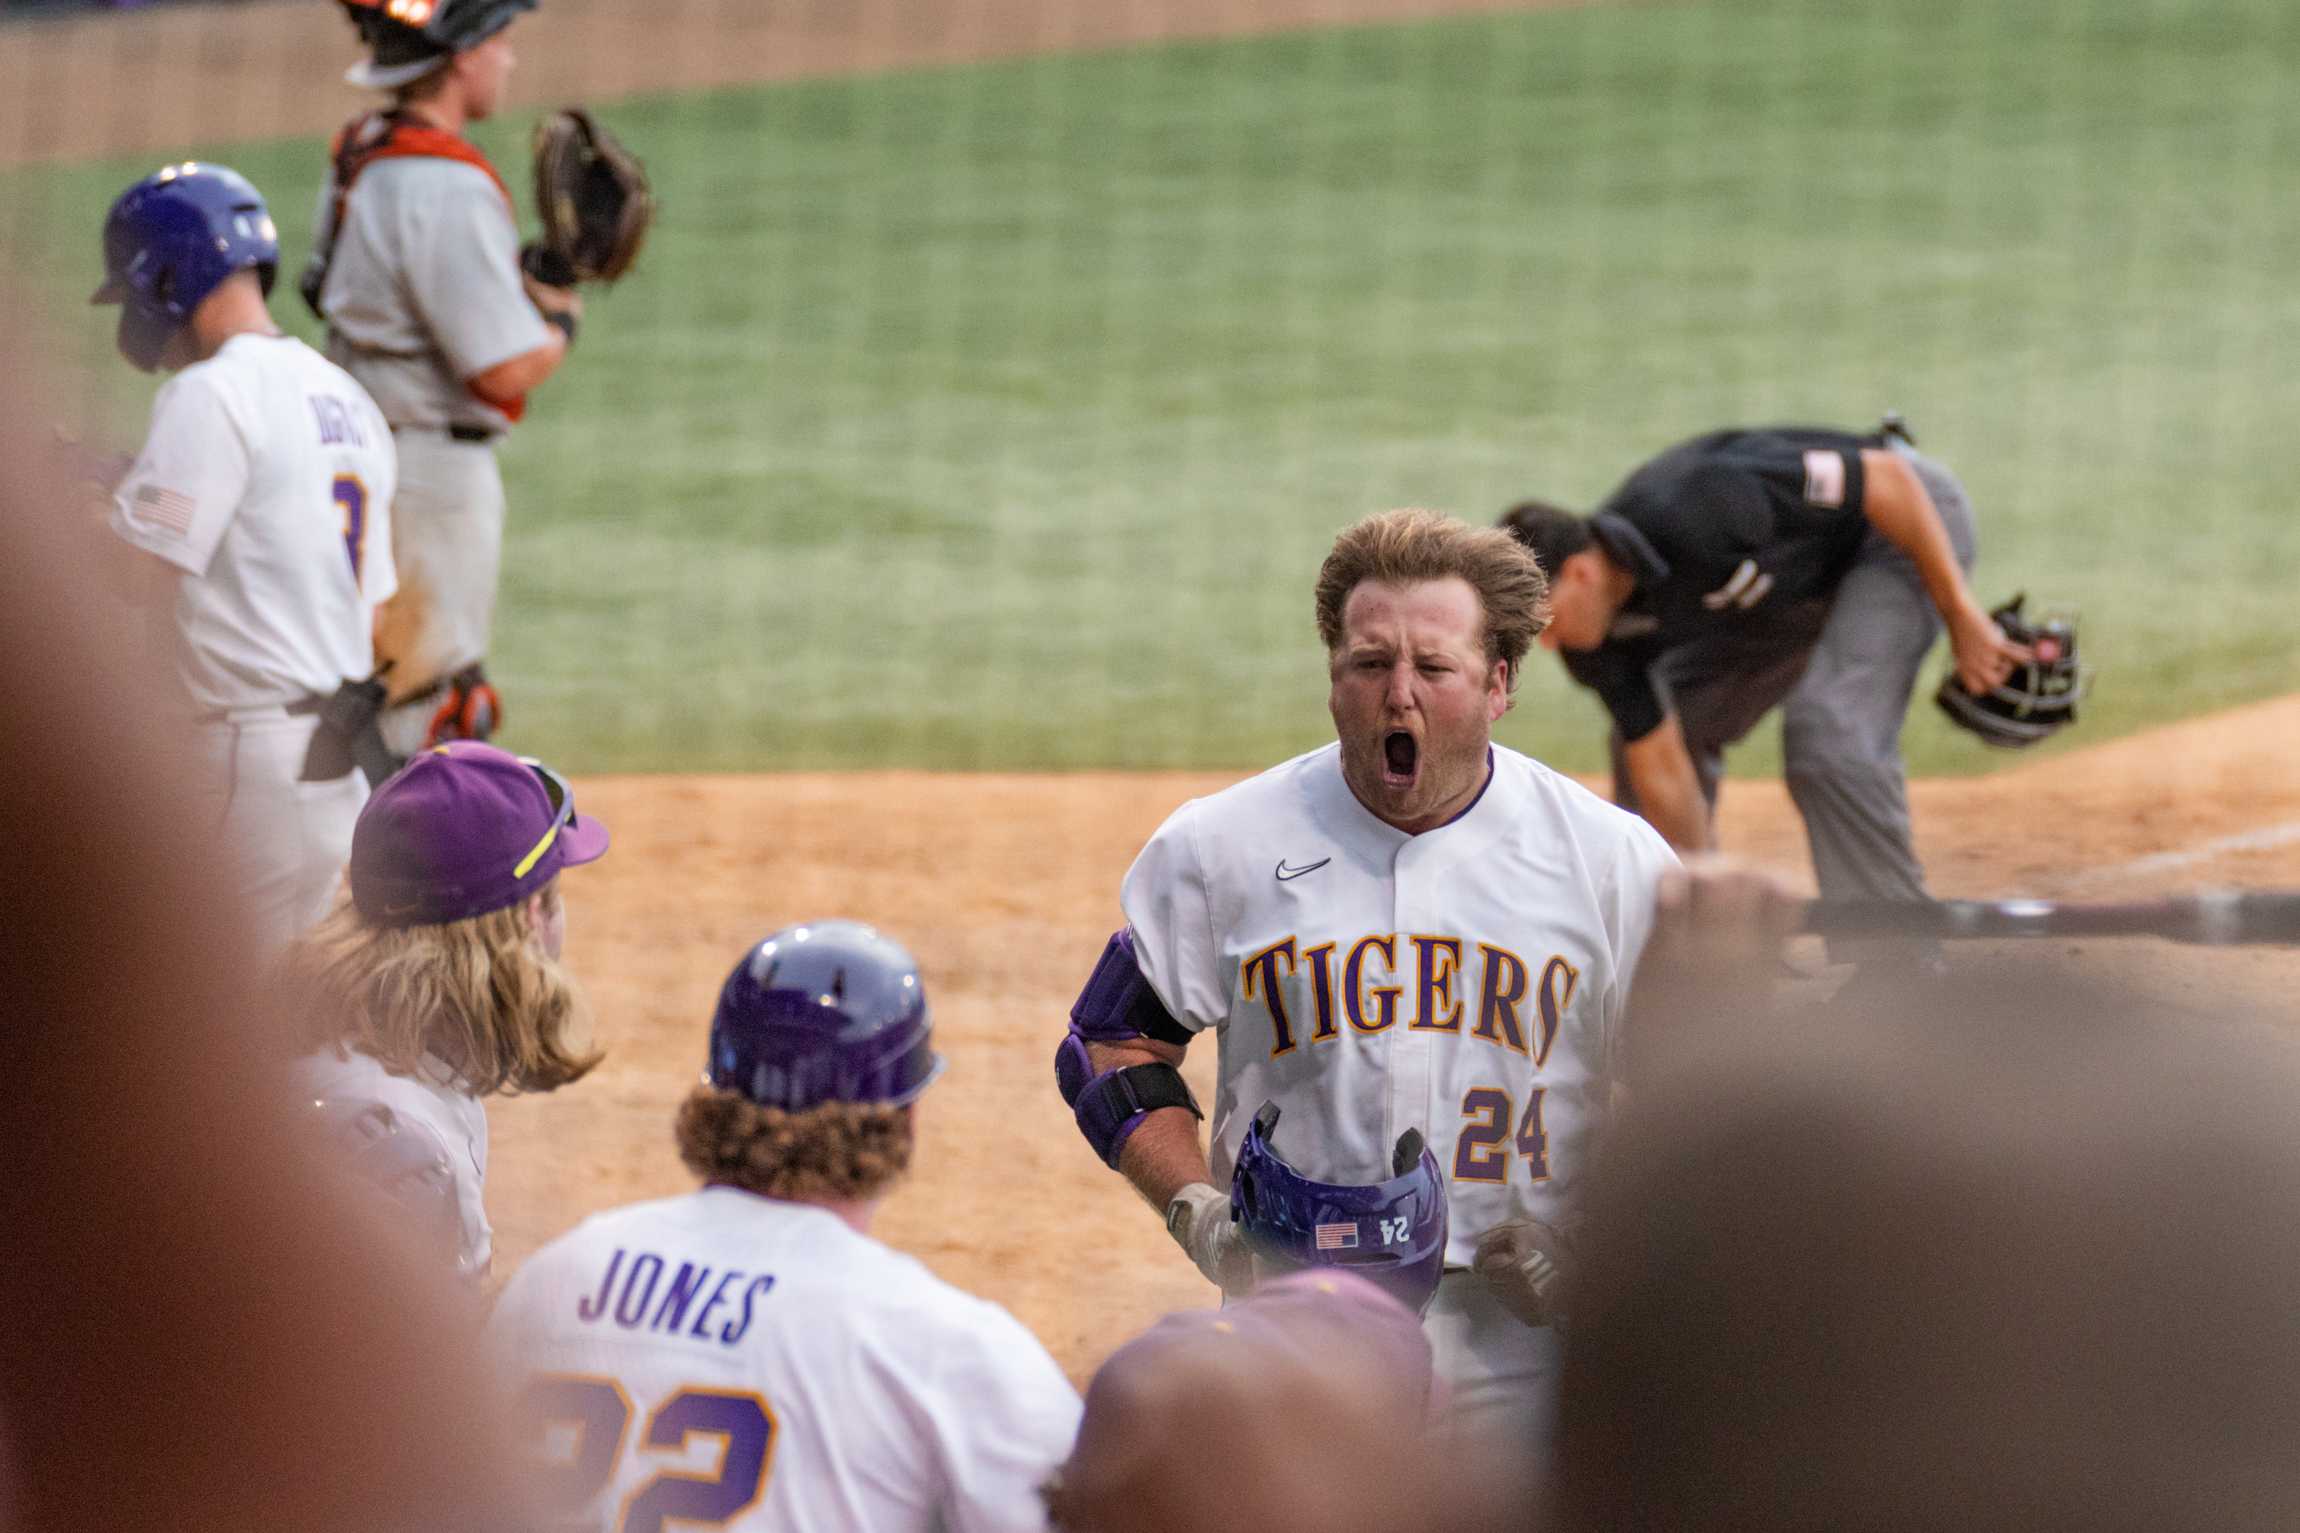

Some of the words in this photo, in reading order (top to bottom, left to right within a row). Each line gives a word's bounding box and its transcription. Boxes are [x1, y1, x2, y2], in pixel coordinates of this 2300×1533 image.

[1242, 934, 1578, 1069] TIGERS
[1452, 1086, 1550, 1184] 24
[1379, 1216, 1409, 1245] 24
[577, 1247, 776, 1344] JONES
